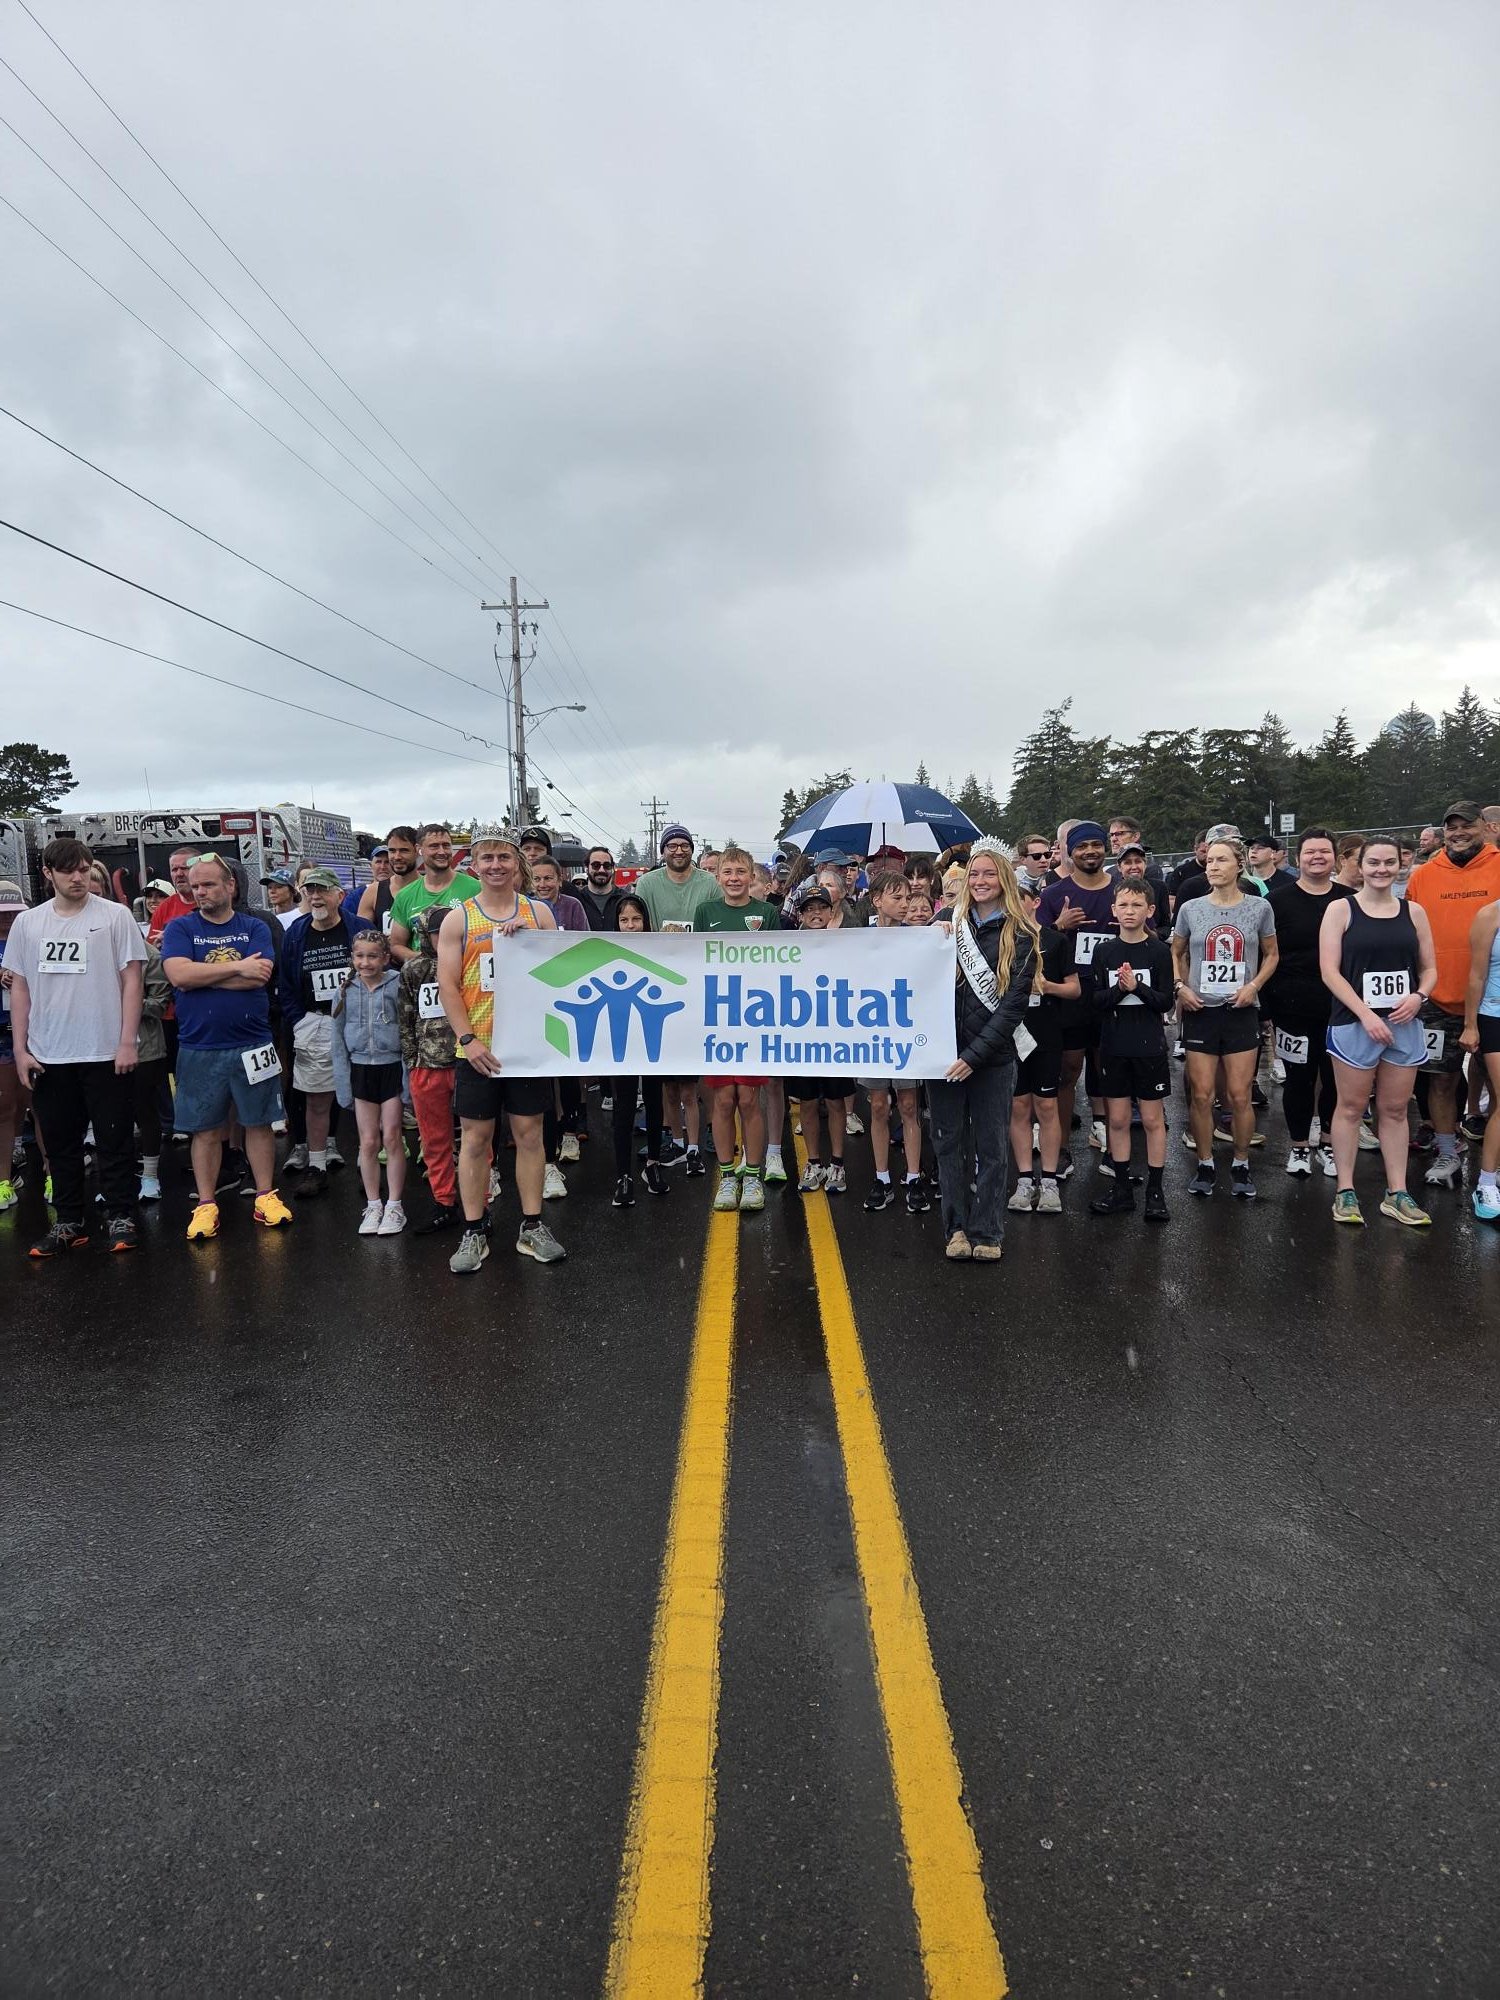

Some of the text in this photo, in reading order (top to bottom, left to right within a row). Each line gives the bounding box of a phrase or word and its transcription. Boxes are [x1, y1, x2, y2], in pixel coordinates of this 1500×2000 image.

[1440, 890, 1489, 900] HARLEY-DAVIDSON
[45, 941, 80, 962] 272
[705, 940, 802, 964] Florence
[956, 921, 977, 972] rincess
[1207, 964, 1238, 983] 321
[1371, 974, 1405, 996] 366
[704, 974, 914, 1028] Habitat
[704, 1034, 748, 1063] for
[1278, 1033, 1303, 1055] 162
[250, 1046, 278, 1072] 138
